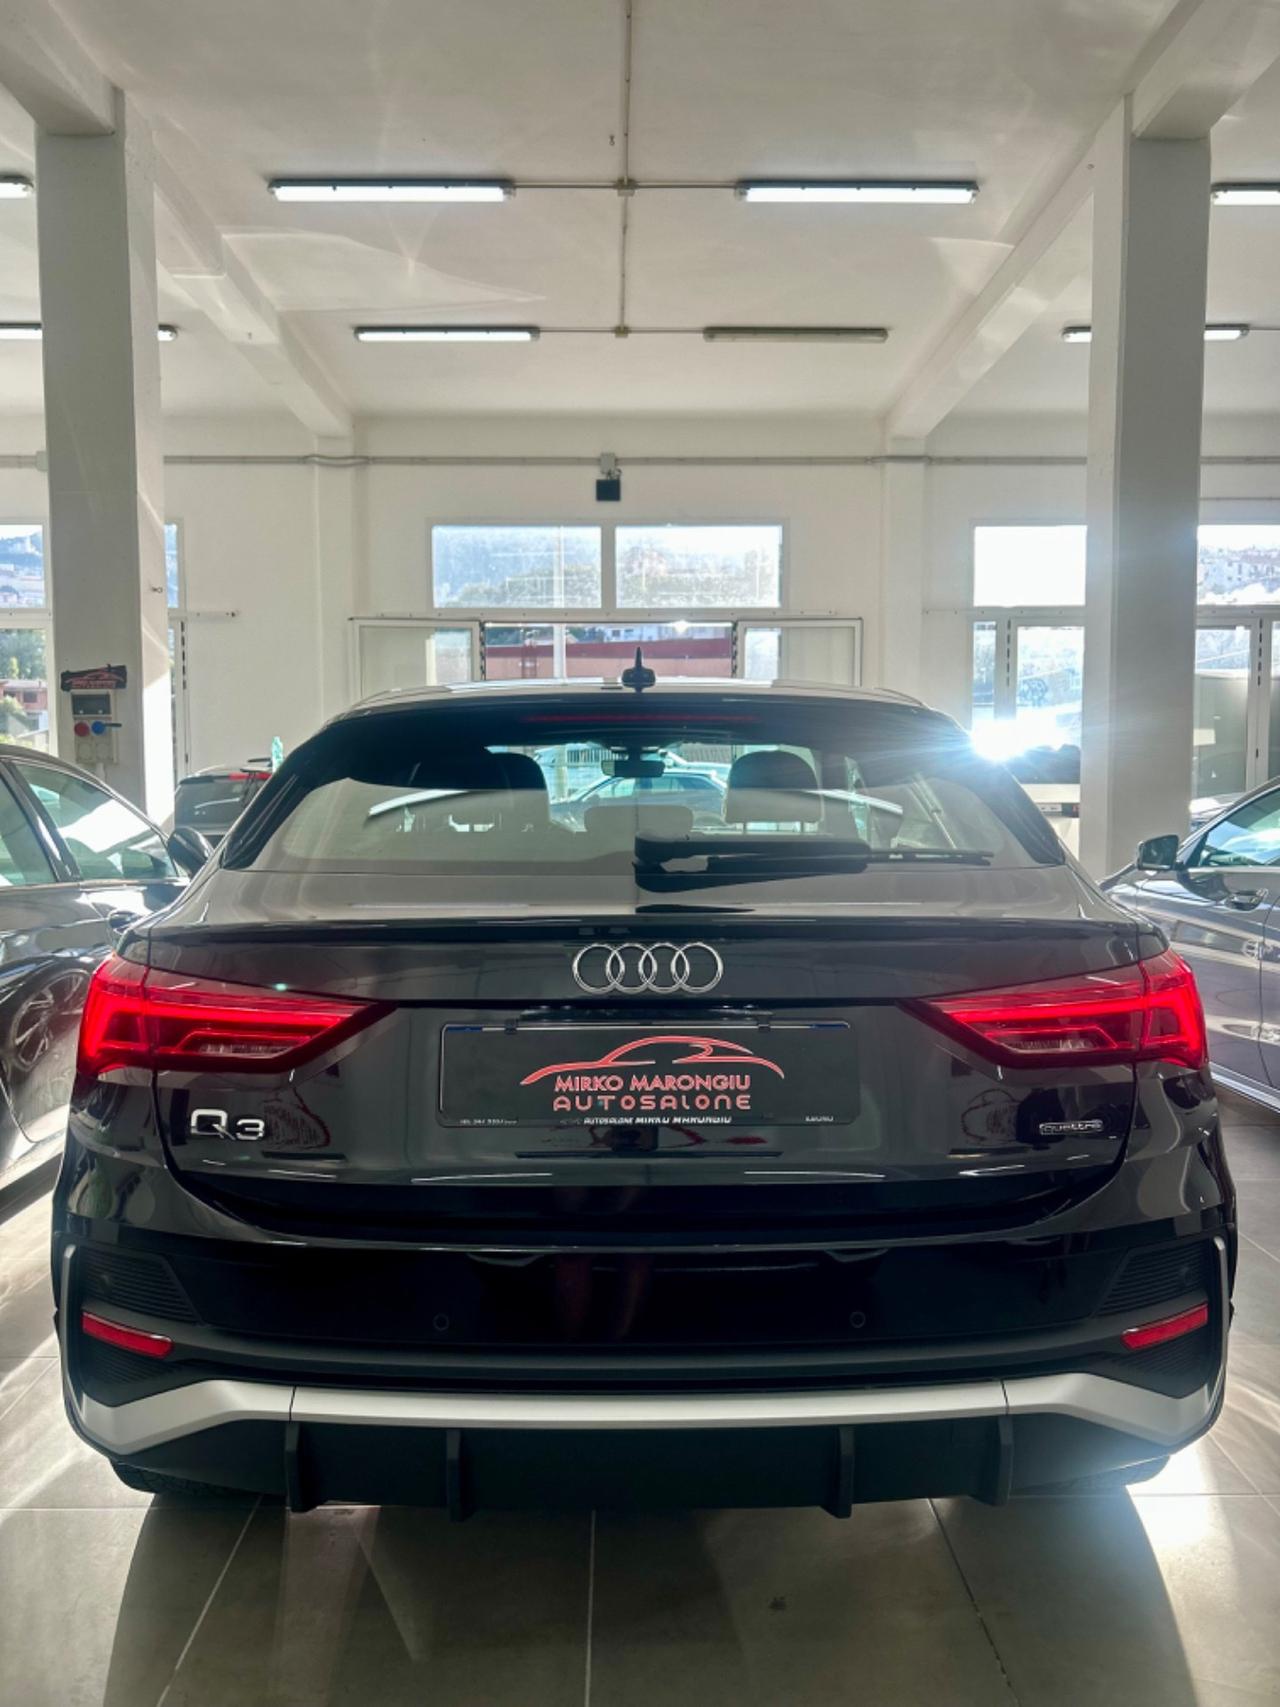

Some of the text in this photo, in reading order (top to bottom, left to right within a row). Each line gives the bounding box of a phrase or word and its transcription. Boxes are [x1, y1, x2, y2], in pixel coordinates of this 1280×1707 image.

[554, 1074, 751, 1092] MIRKO MARONGIU
[553, 1094, 751, 1111] AUTOSALONE
[190, 1108, 265, 1140] Q3
